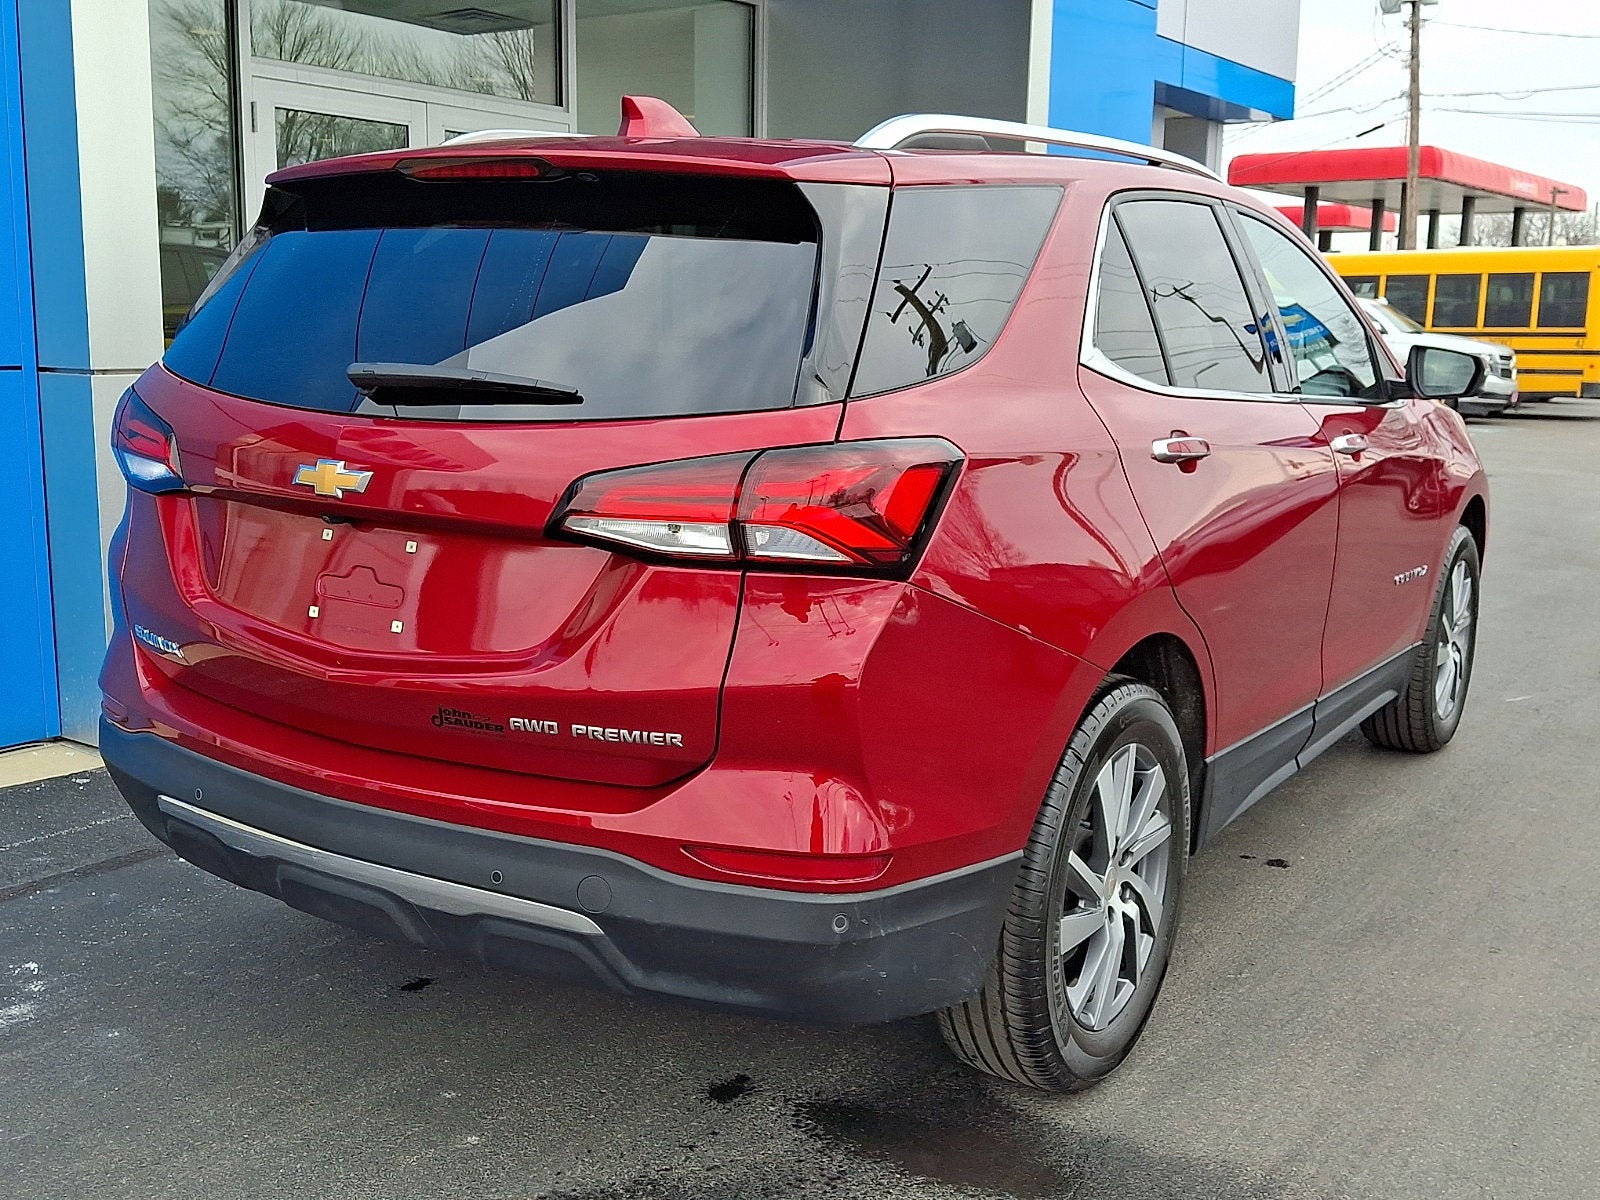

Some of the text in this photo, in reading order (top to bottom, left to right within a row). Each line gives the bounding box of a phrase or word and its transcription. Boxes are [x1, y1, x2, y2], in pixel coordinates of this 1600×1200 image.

[444, 717, 505, 733] SAUDER
[509, 717, 559, 735] AWD
[571, 724, 684, 748] PREMIER
